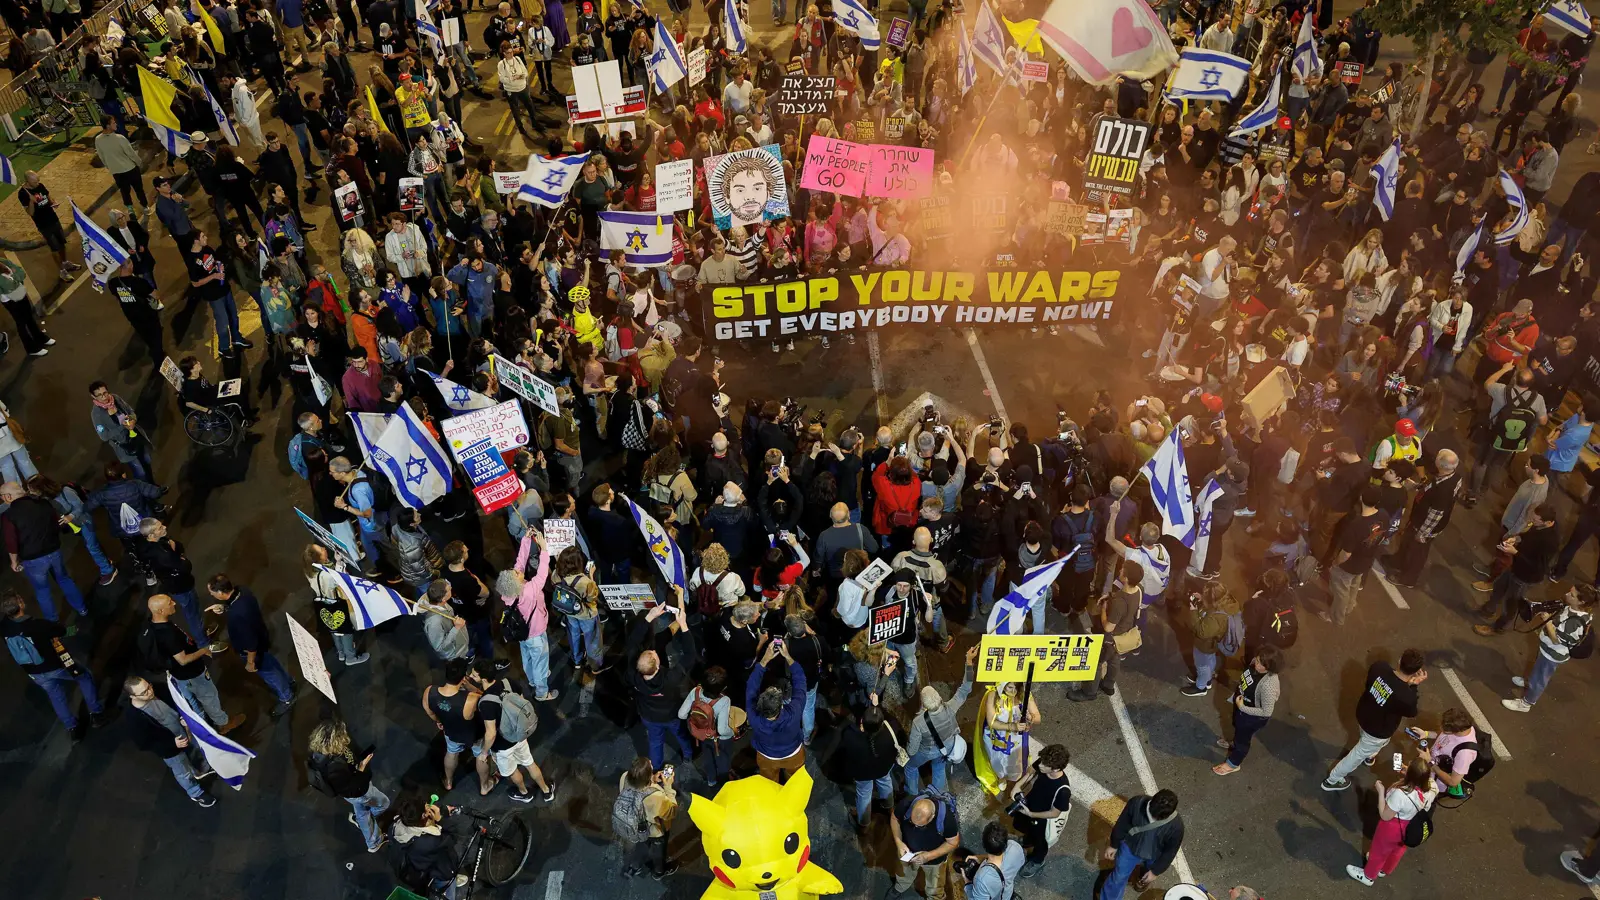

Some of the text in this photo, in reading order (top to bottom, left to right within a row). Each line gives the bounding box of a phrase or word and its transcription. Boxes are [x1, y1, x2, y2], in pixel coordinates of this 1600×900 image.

[782, 77, 834, 88] תציל את
[781, 90, 833, 100] המדינה
[778, 103, 827, 114] מעצמך
[1094, 120, 1147, 158] כולם
[826, 141, 856, 155] LET
[878, 148, 919, 162] שחרר
[809, 154, 867, 173] MY PEOPLE
[888, 163, 909, 174] את
[1088, 154, 1138, 182] עכשיו!
[818, 169, 845, 187] GO
[884, 176, 917, 191] כולנו
[712, 270, 1121, 318] STOP YOUR WARS
[714, 301, 1113, 340] GET EVERYBODY HOME NOW!
[452, 402, 515, 424] בבית המקדש
[445, 410, 519, 438] השלישי הכהן הגדול
[473, 422, 504, 437] נתניהו
[496, 426, 521, 440] מקריב
[475, 462, 497, 475] חקירה
[479, 476, 514, 495] עד החטוף
[486, 486, 515, 503] האחרון
[876, 610, 900, 623] ויתרה
[875, 617, 900, 633] העם
[1076, 636, 1093, 647] זו
[985, 647, 1090, 671] בגידה
